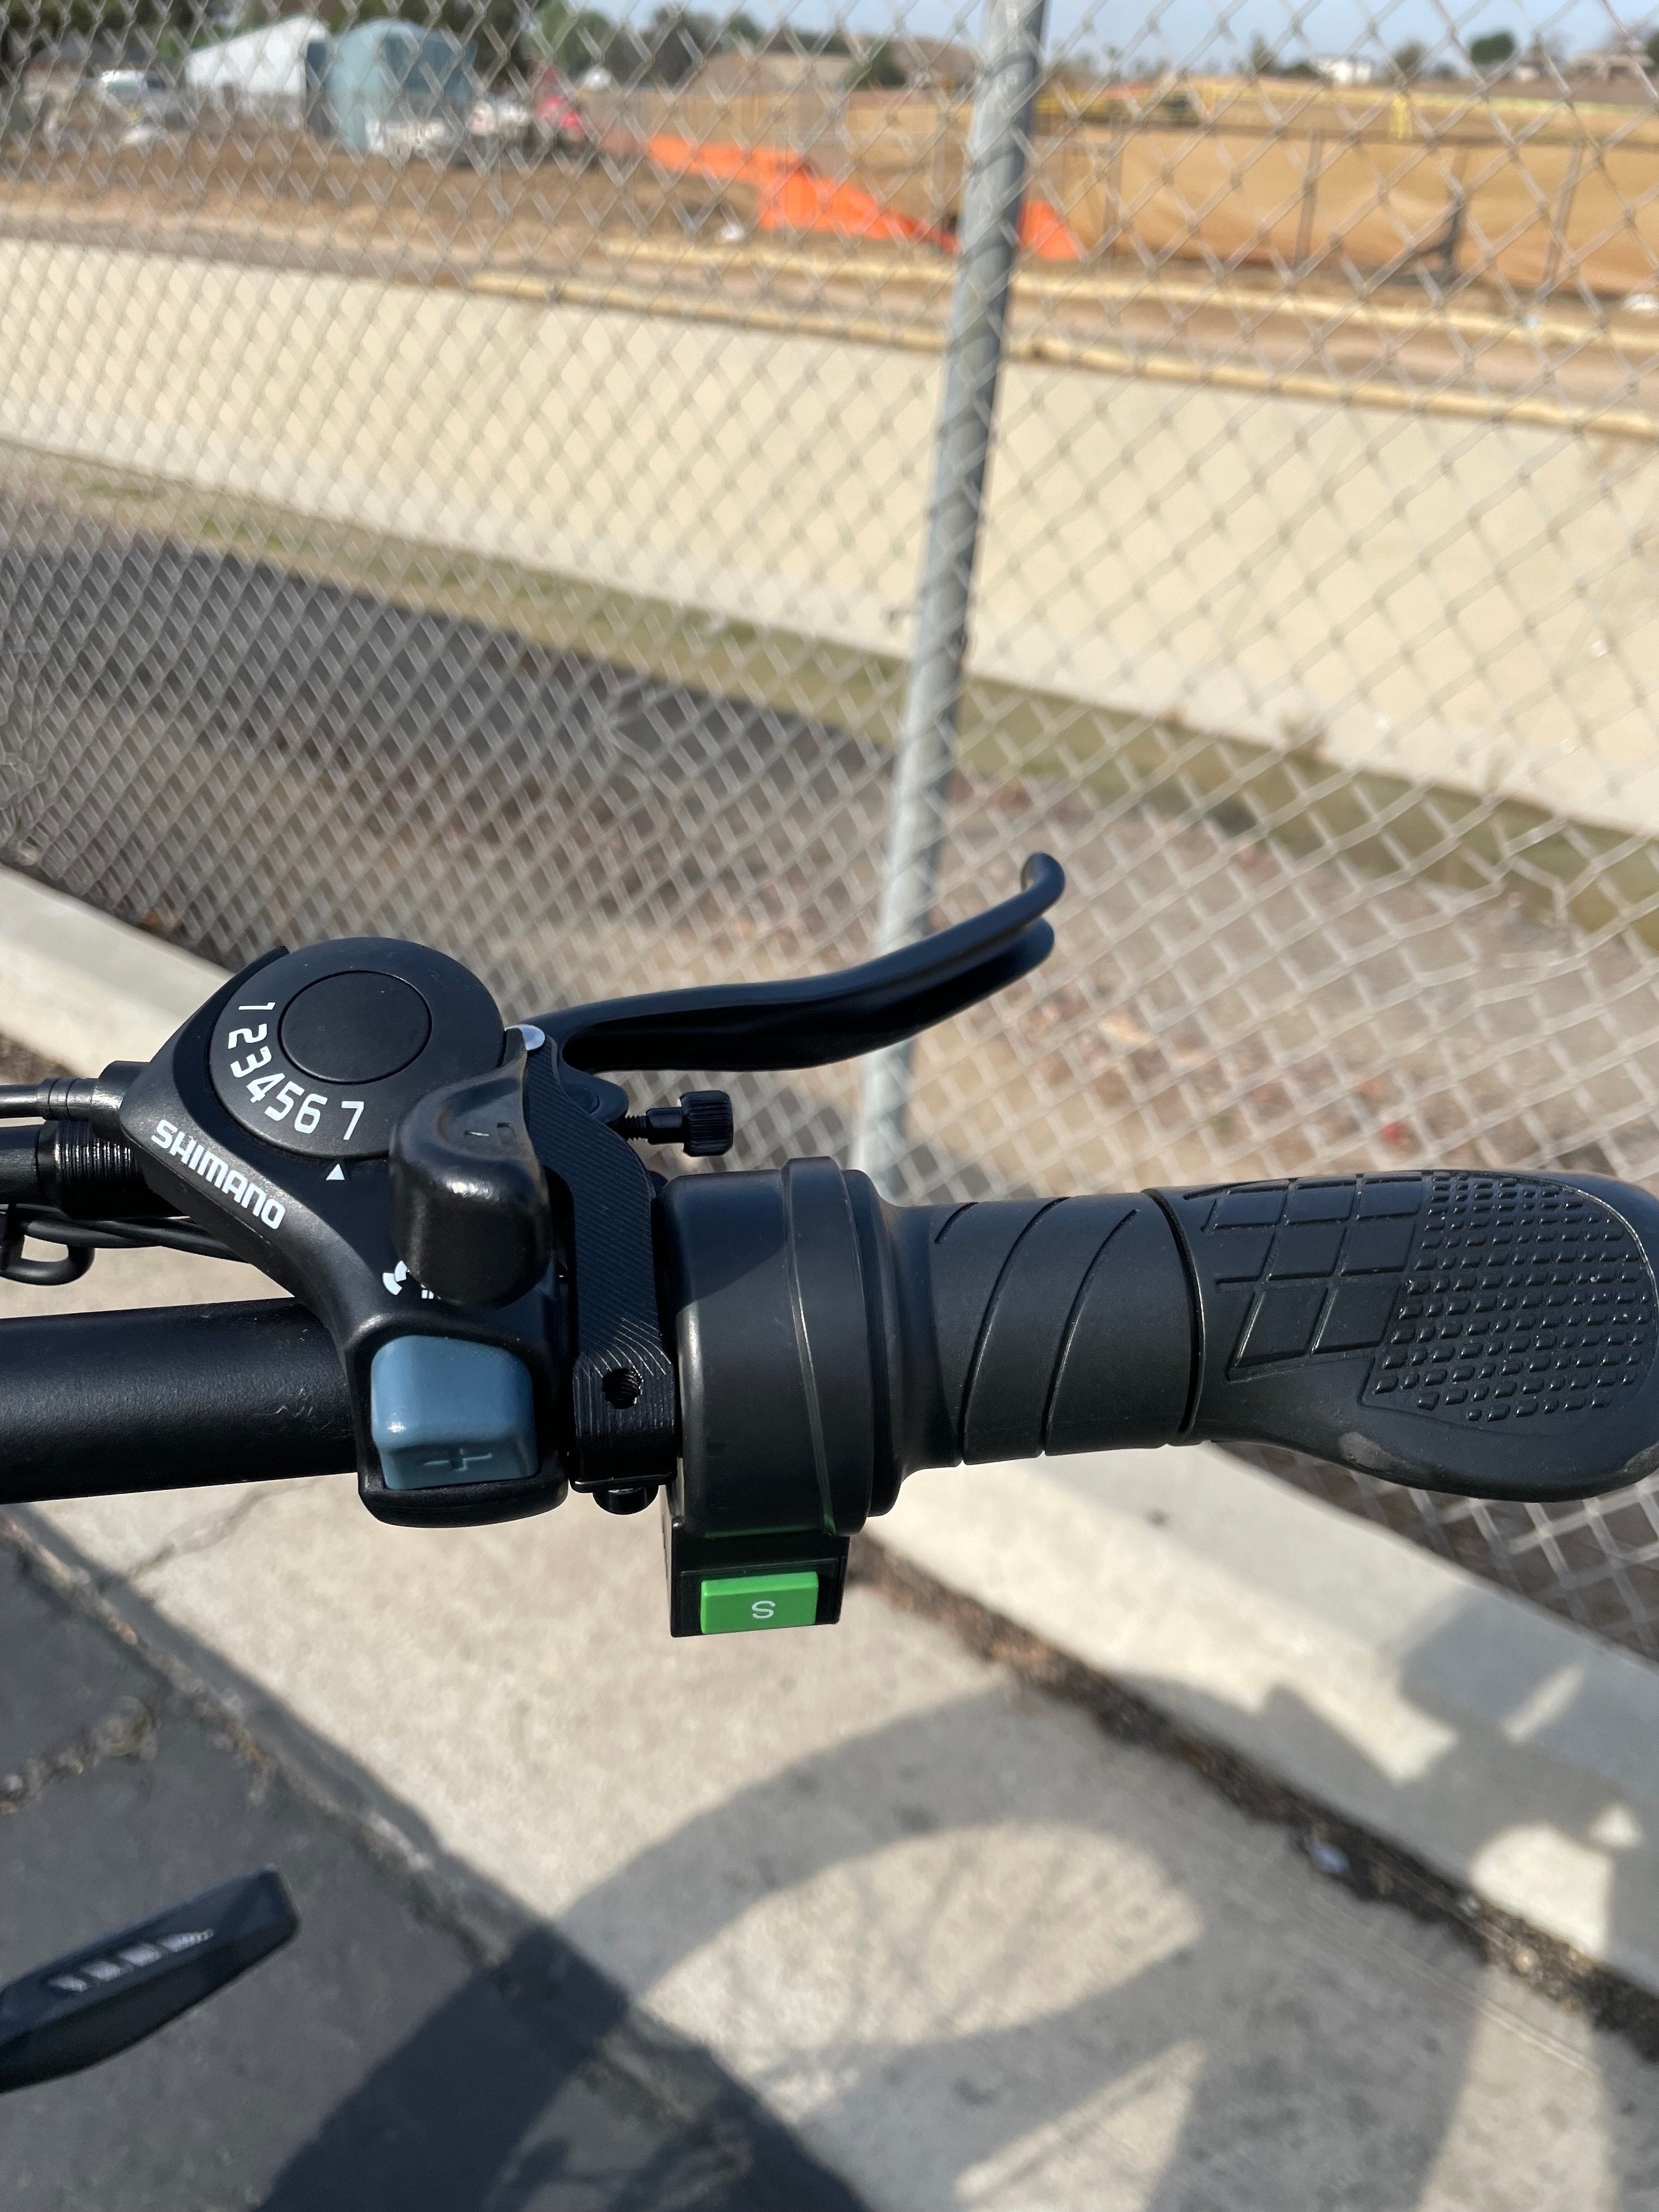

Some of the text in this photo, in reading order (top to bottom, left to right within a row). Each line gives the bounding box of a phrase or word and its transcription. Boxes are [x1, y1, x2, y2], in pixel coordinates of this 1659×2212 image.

[341, 1101, 364, 1141] 7
[151, 1119, 286, 1229] SHIMANO
[751, 1600, 776, 1619] S
